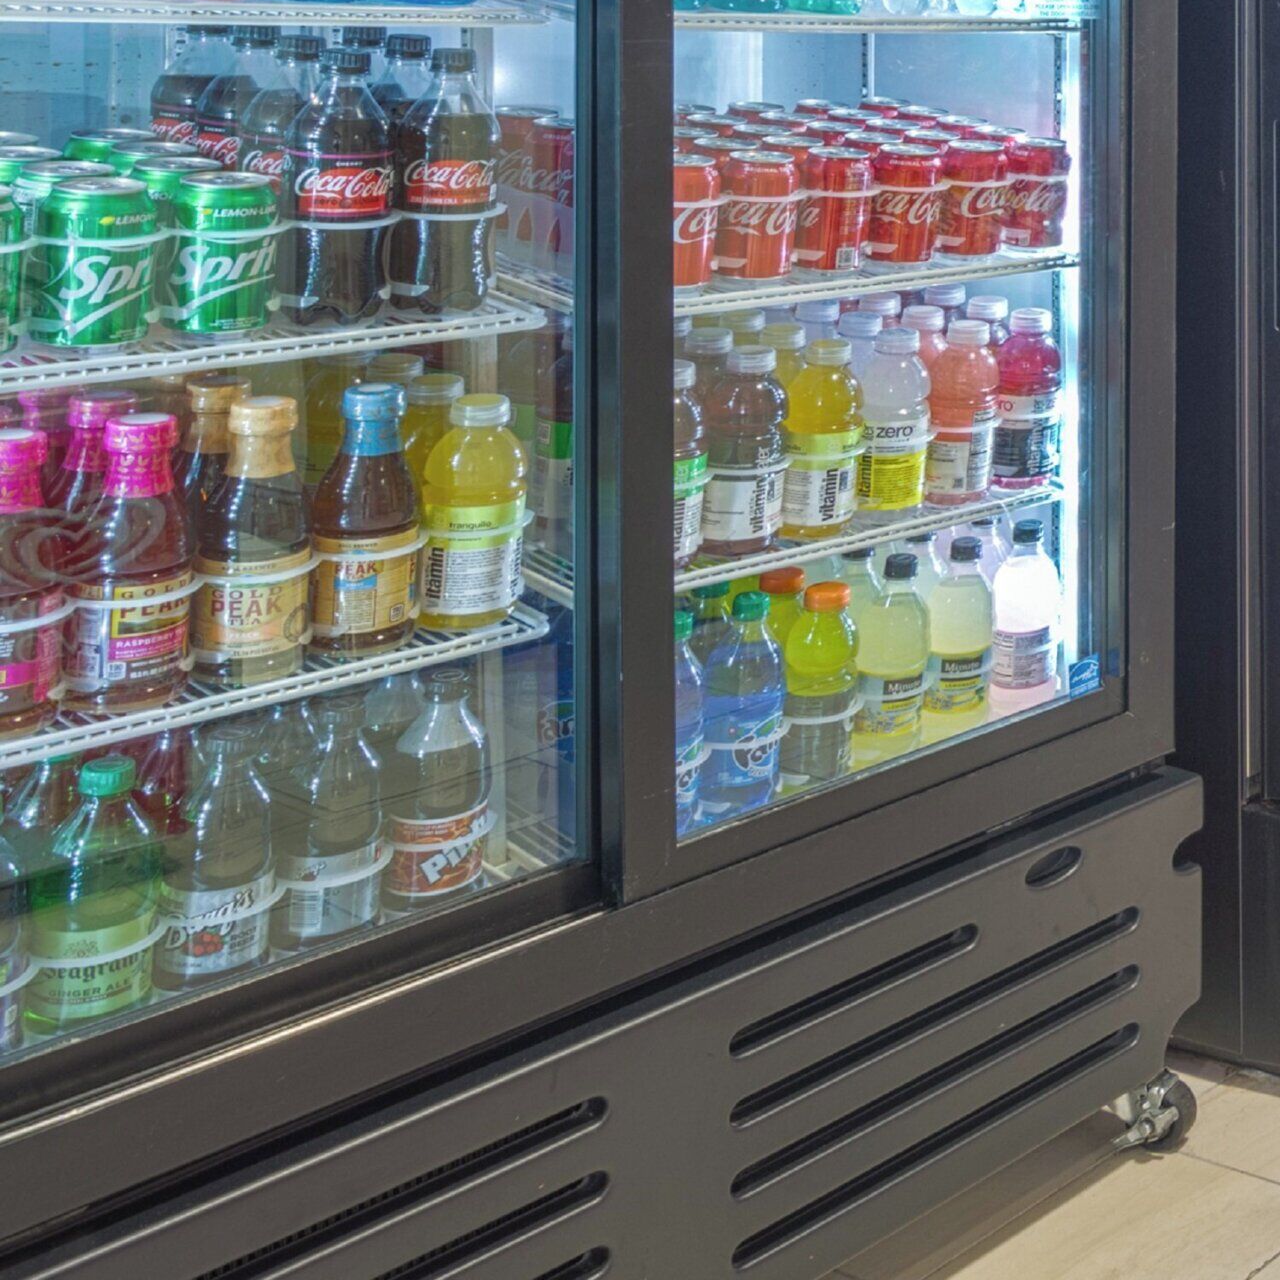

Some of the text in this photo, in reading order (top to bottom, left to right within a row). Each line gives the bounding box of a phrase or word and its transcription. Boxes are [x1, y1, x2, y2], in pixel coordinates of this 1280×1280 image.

[404, 158, 496, 190] Coca-Cola
[876, 424, 914, 439] zero
[750, 476, 768, 535] vitamin
[819, 468, 839, 523] vitamin
[211, 585, 283, 601] GOLD
[210, 596, 283, 620] PEAK
